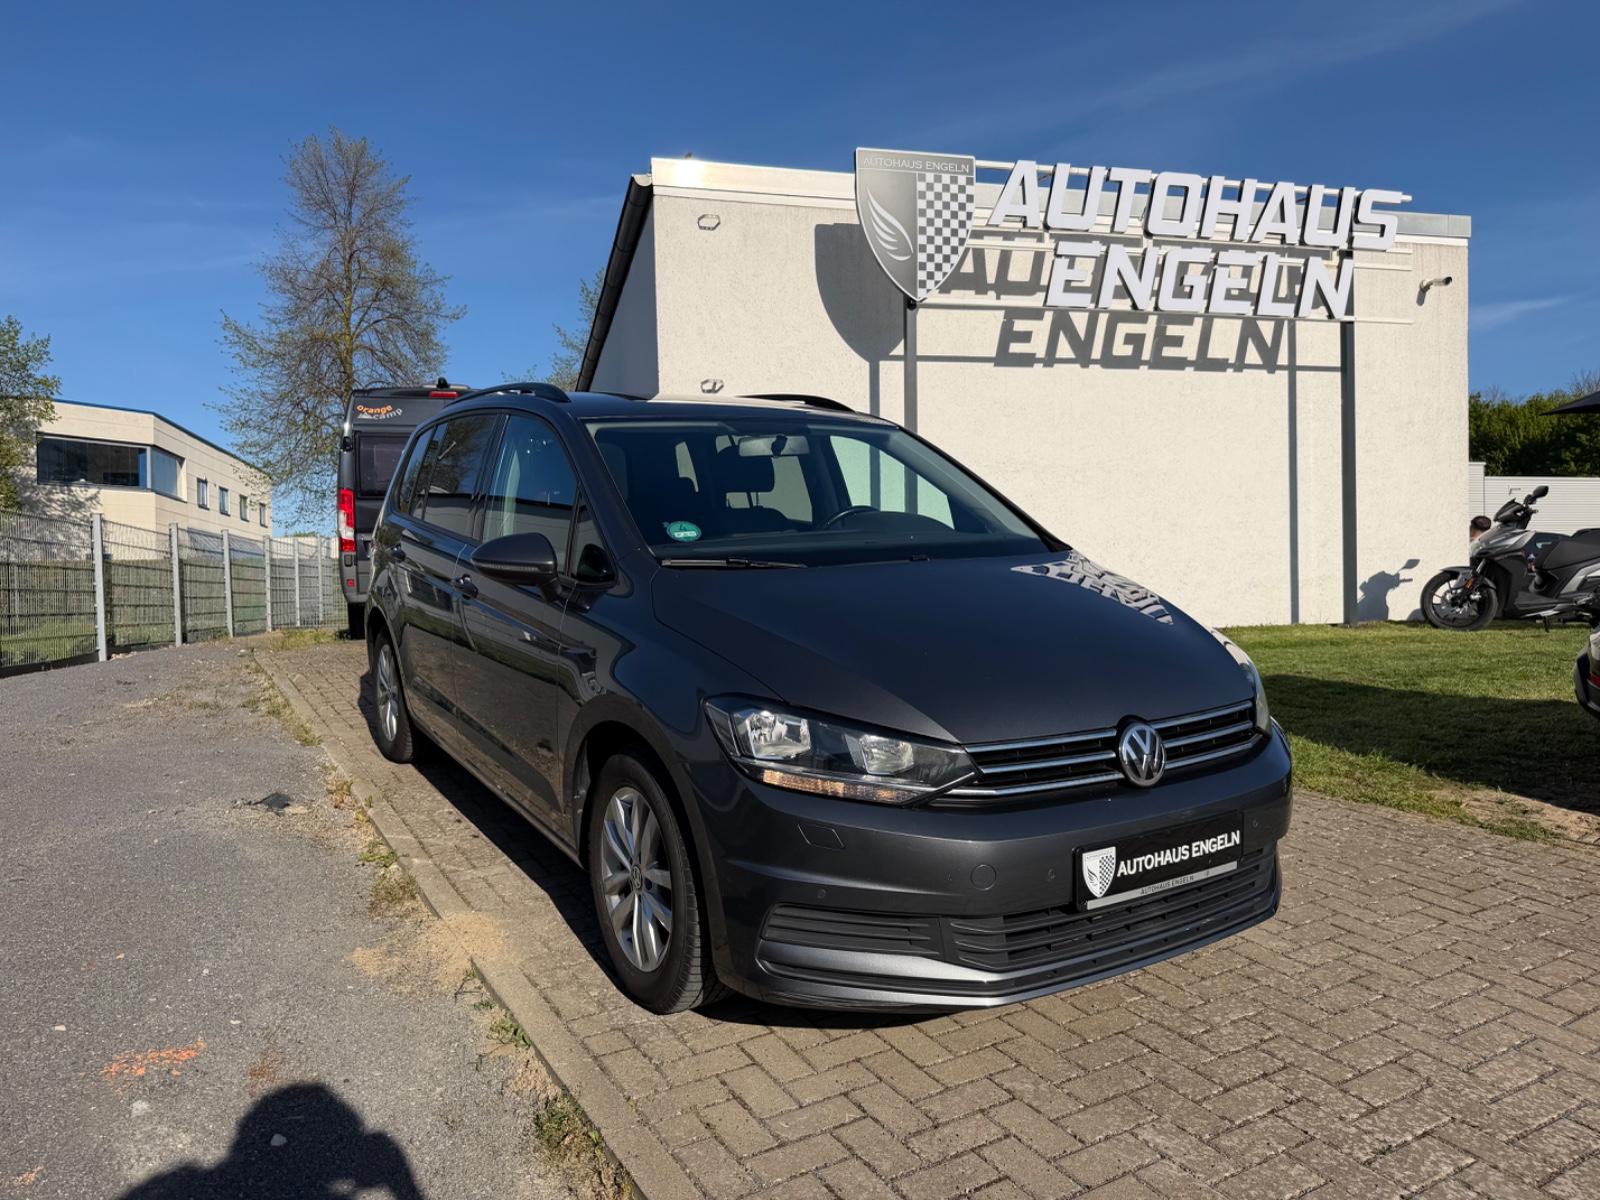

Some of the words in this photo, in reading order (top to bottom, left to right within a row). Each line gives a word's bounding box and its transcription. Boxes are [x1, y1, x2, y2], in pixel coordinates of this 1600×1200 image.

[863, 158, 922, 169] AUTOHAUS
[926, 161, 969, 174] ENGELN
[988, 159, 1399, 251] AUTOHAUS
[1046, 241, 1355, 319] ENGELN
[995, 309, 1284, 374] ENGELN
[1117, 845, 1190, 877] AUTOHAUS
[1192, 830, 1241, 858] ENGELN
